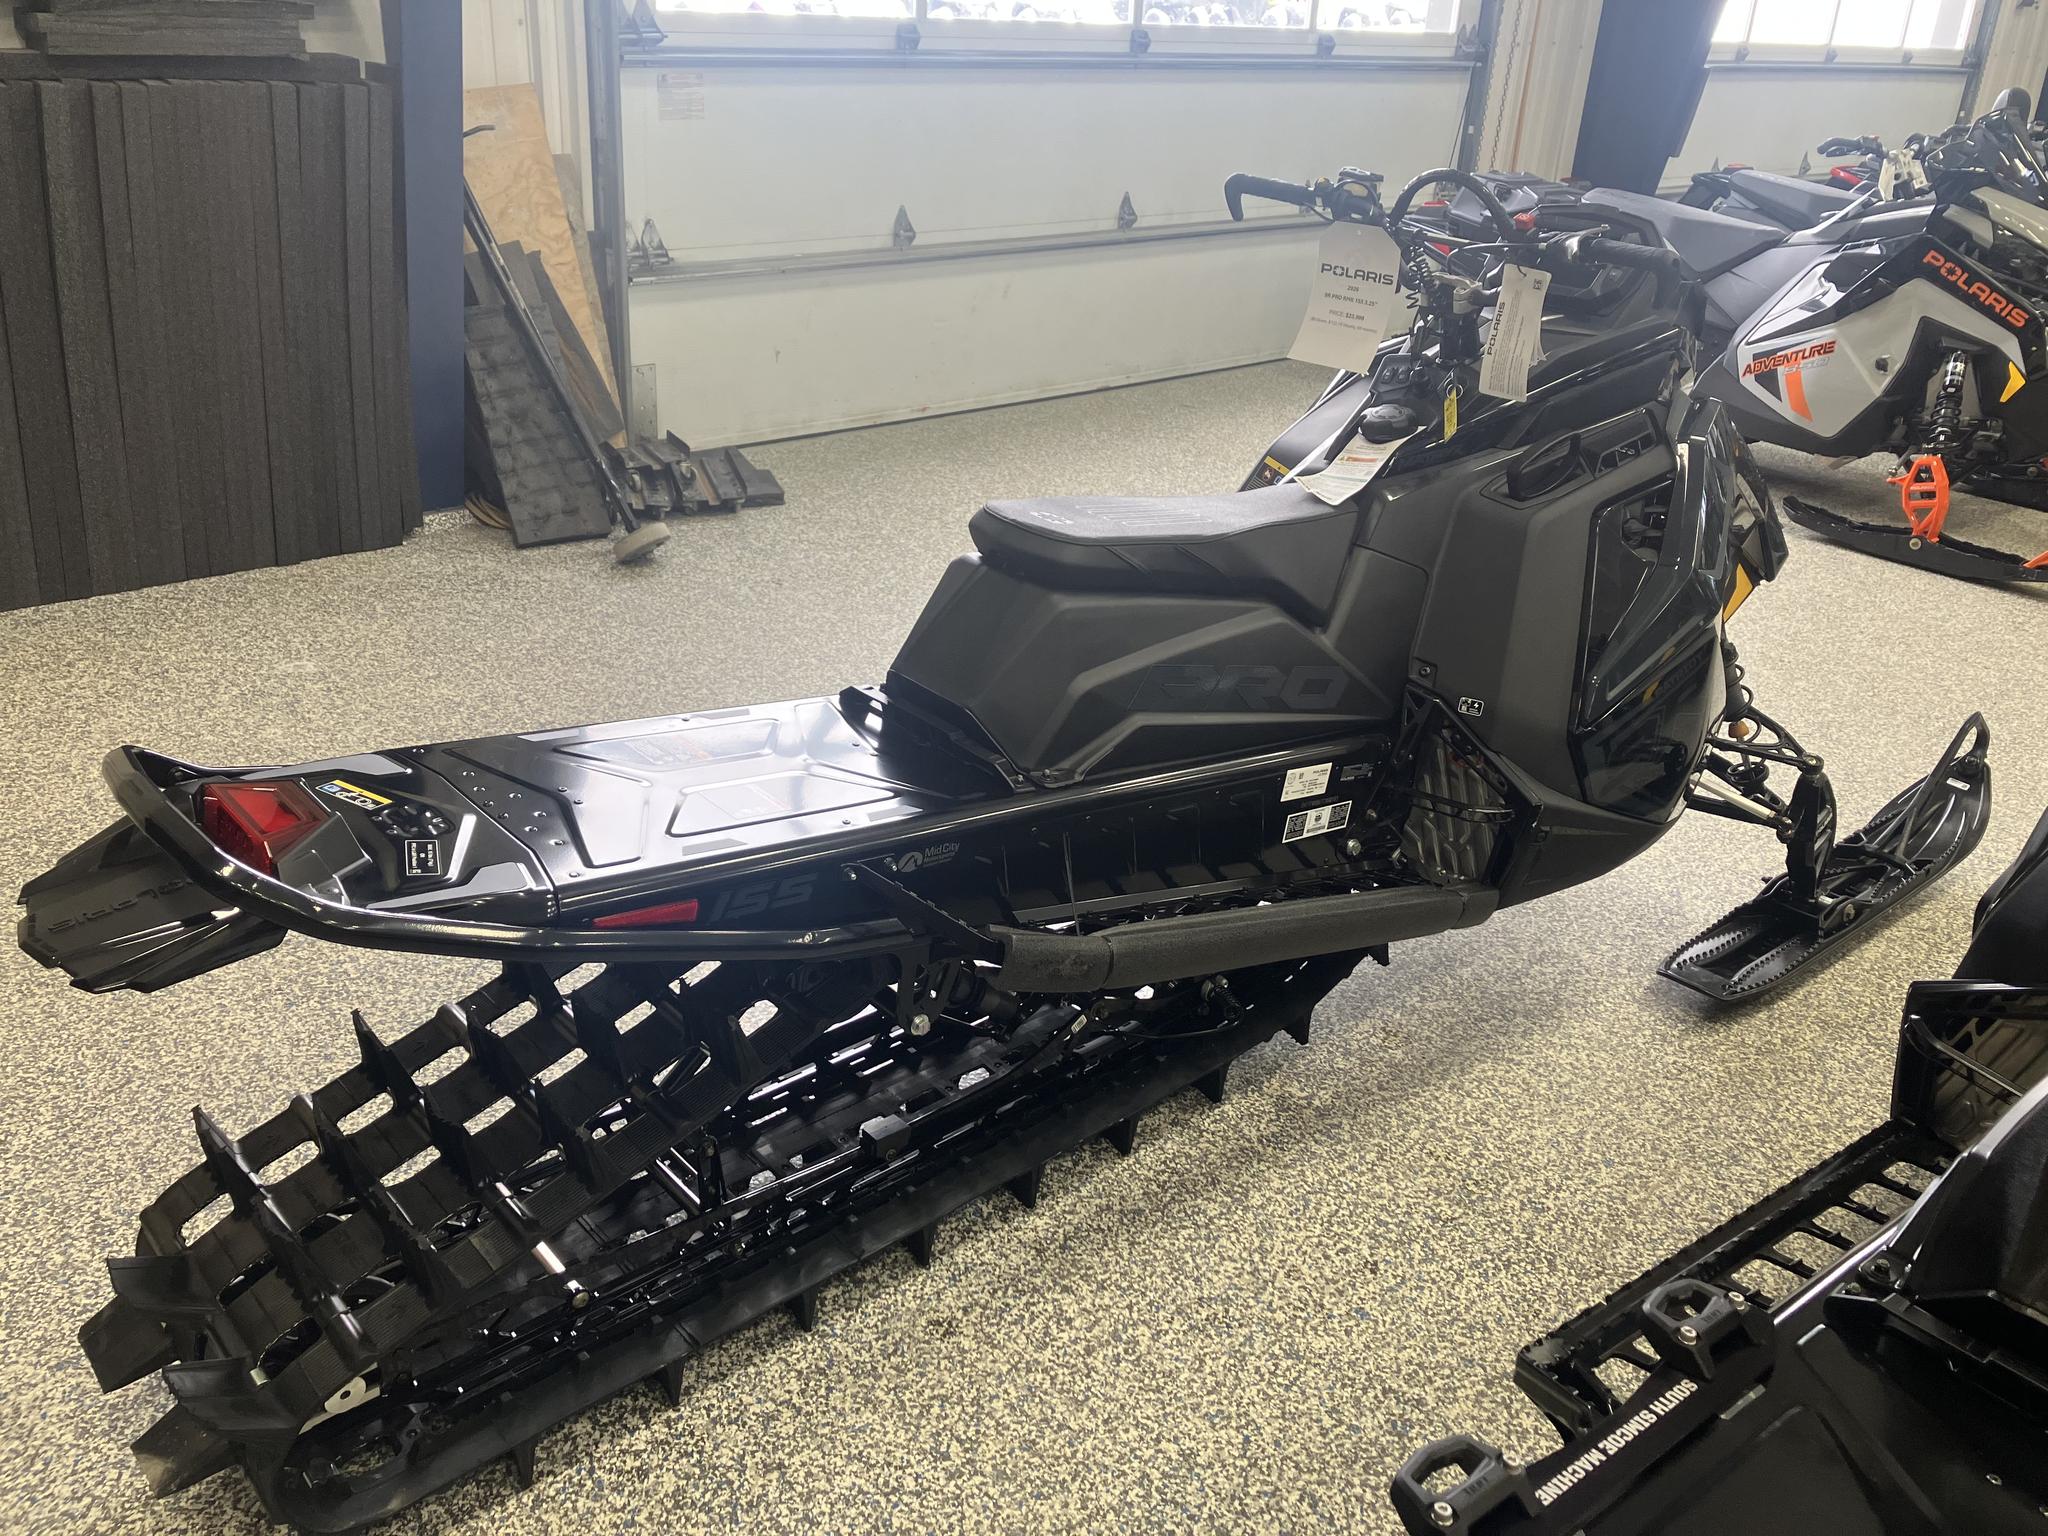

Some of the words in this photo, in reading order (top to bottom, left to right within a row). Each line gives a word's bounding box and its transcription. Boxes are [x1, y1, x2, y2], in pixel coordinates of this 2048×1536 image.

[1321, 263, 1394, 285] POLARIS
[1922, 249, 2030, 328] POLARIS
[1487, 302, 1506, 355] POLARIS
[1741, 340, 1837, 378] ADVENTURE
[1127, 664, 1350, 711] PRO
[47, 879, 193, 934] OLARIS
[706, 872, 818, 925] 155
[1649, 1378, 1699, 1417] SOUTH
[1597, 1409, 1658, 1456] SIMCOE
[1534, 1448, 1607, 1507] MACHINE
